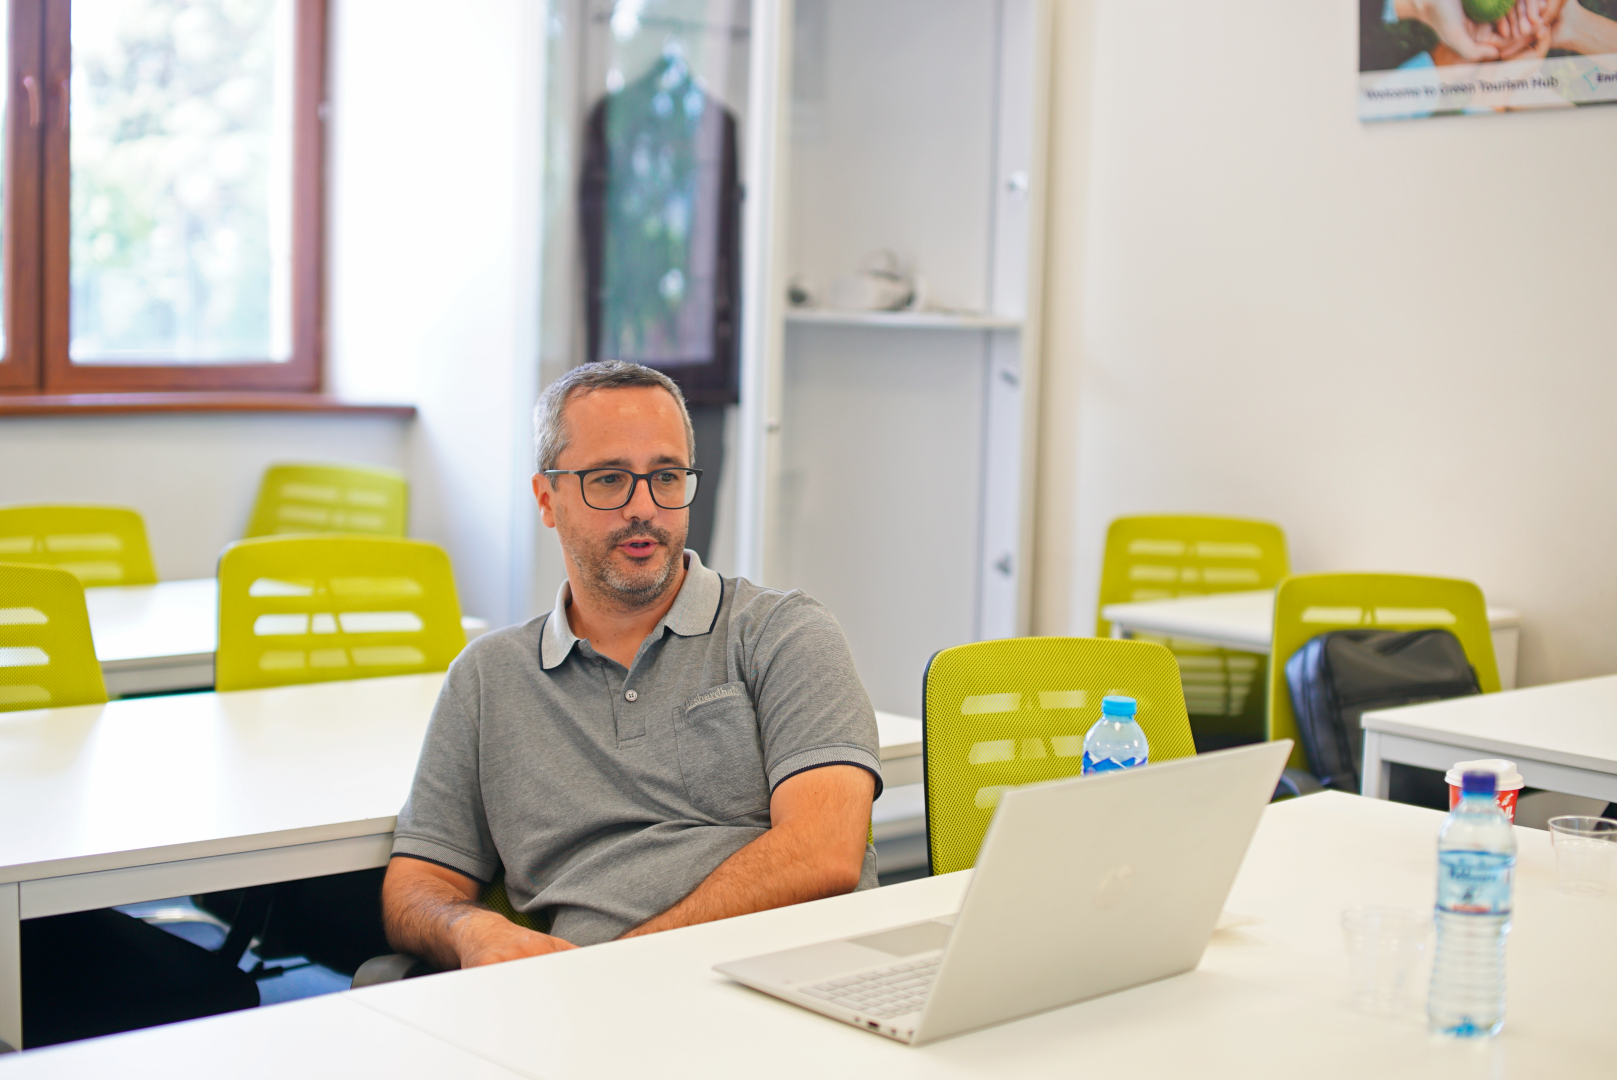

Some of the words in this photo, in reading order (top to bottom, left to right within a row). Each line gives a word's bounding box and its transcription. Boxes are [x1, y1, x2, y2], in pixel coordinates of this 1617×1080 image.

[1366, 86, 1422, 100] Welcome
[1423, 84, 1437, 98] to
[1440, 81, 1476, 96] Green
[1478, 78, 1529, 92] Tourism
[1532, 75, 1559, 89] Hub
